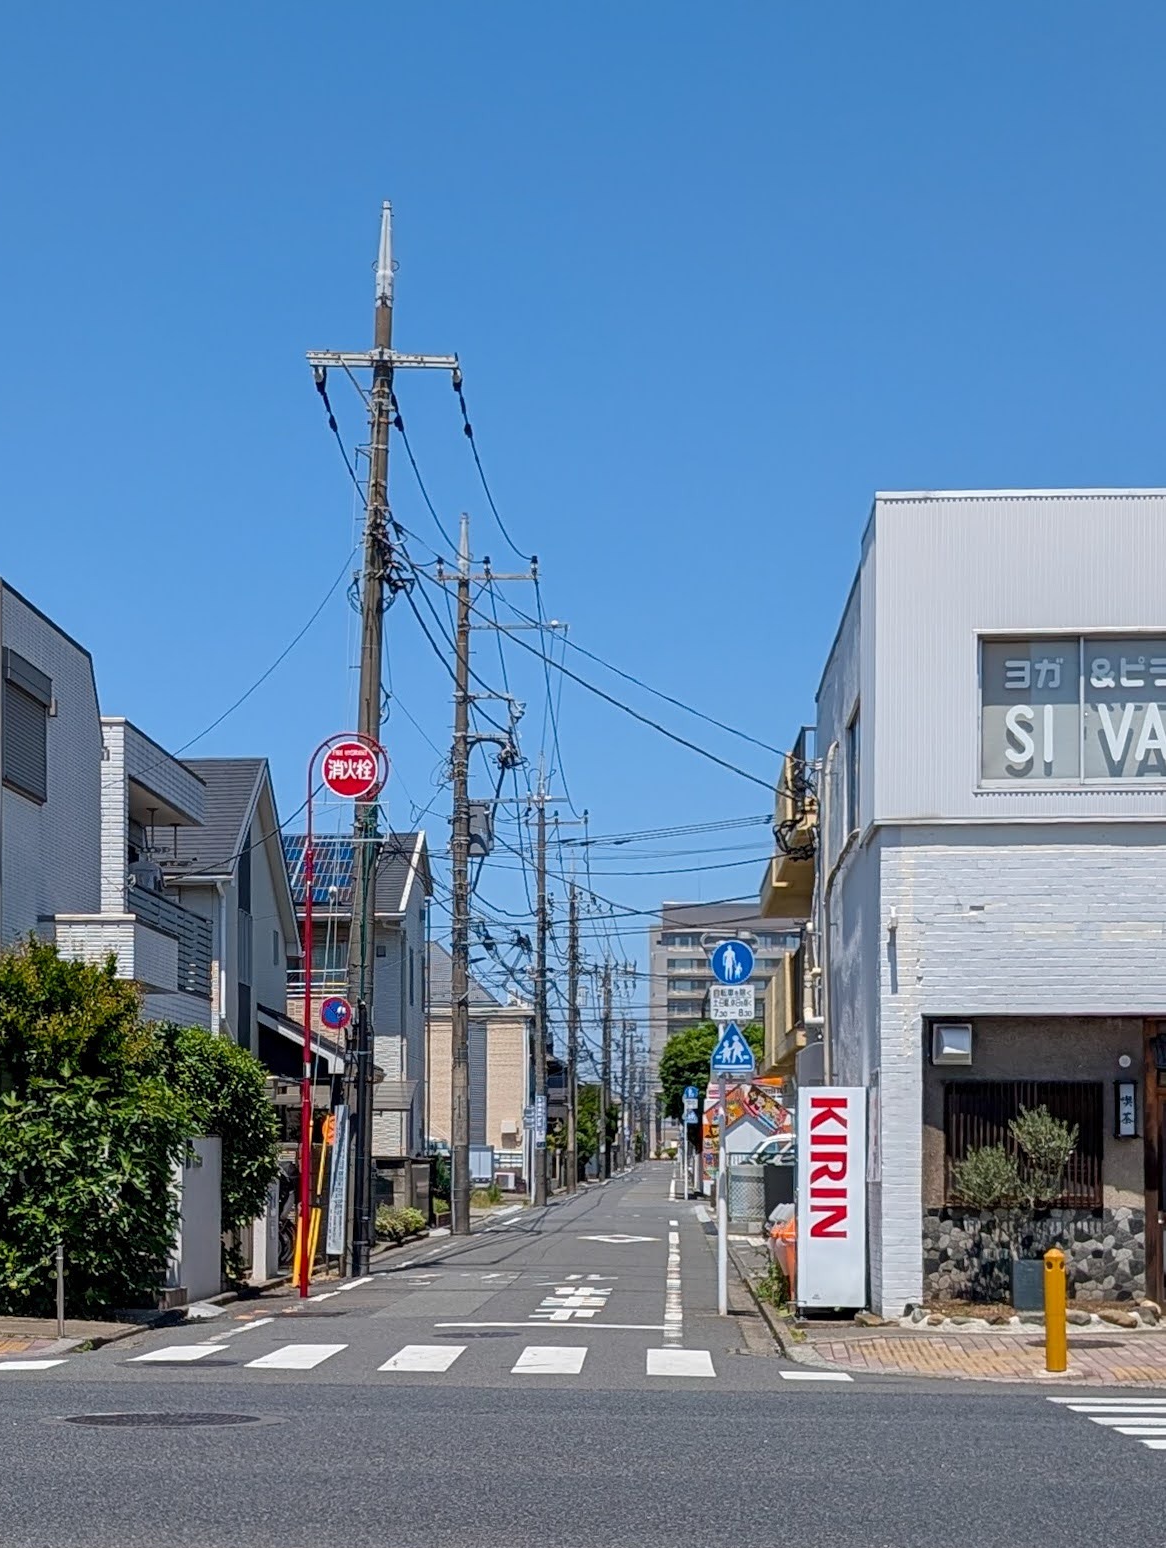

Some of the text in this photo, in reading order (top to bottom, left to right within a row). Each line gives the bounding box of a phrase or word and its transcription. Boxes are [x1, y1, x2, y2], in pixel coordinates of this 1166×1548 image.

[1005, 658, 1063, 688] ヨガ
[328, 759, 373, 780] 消火栓
[810, 1098, 848, 1238] KIRIN
